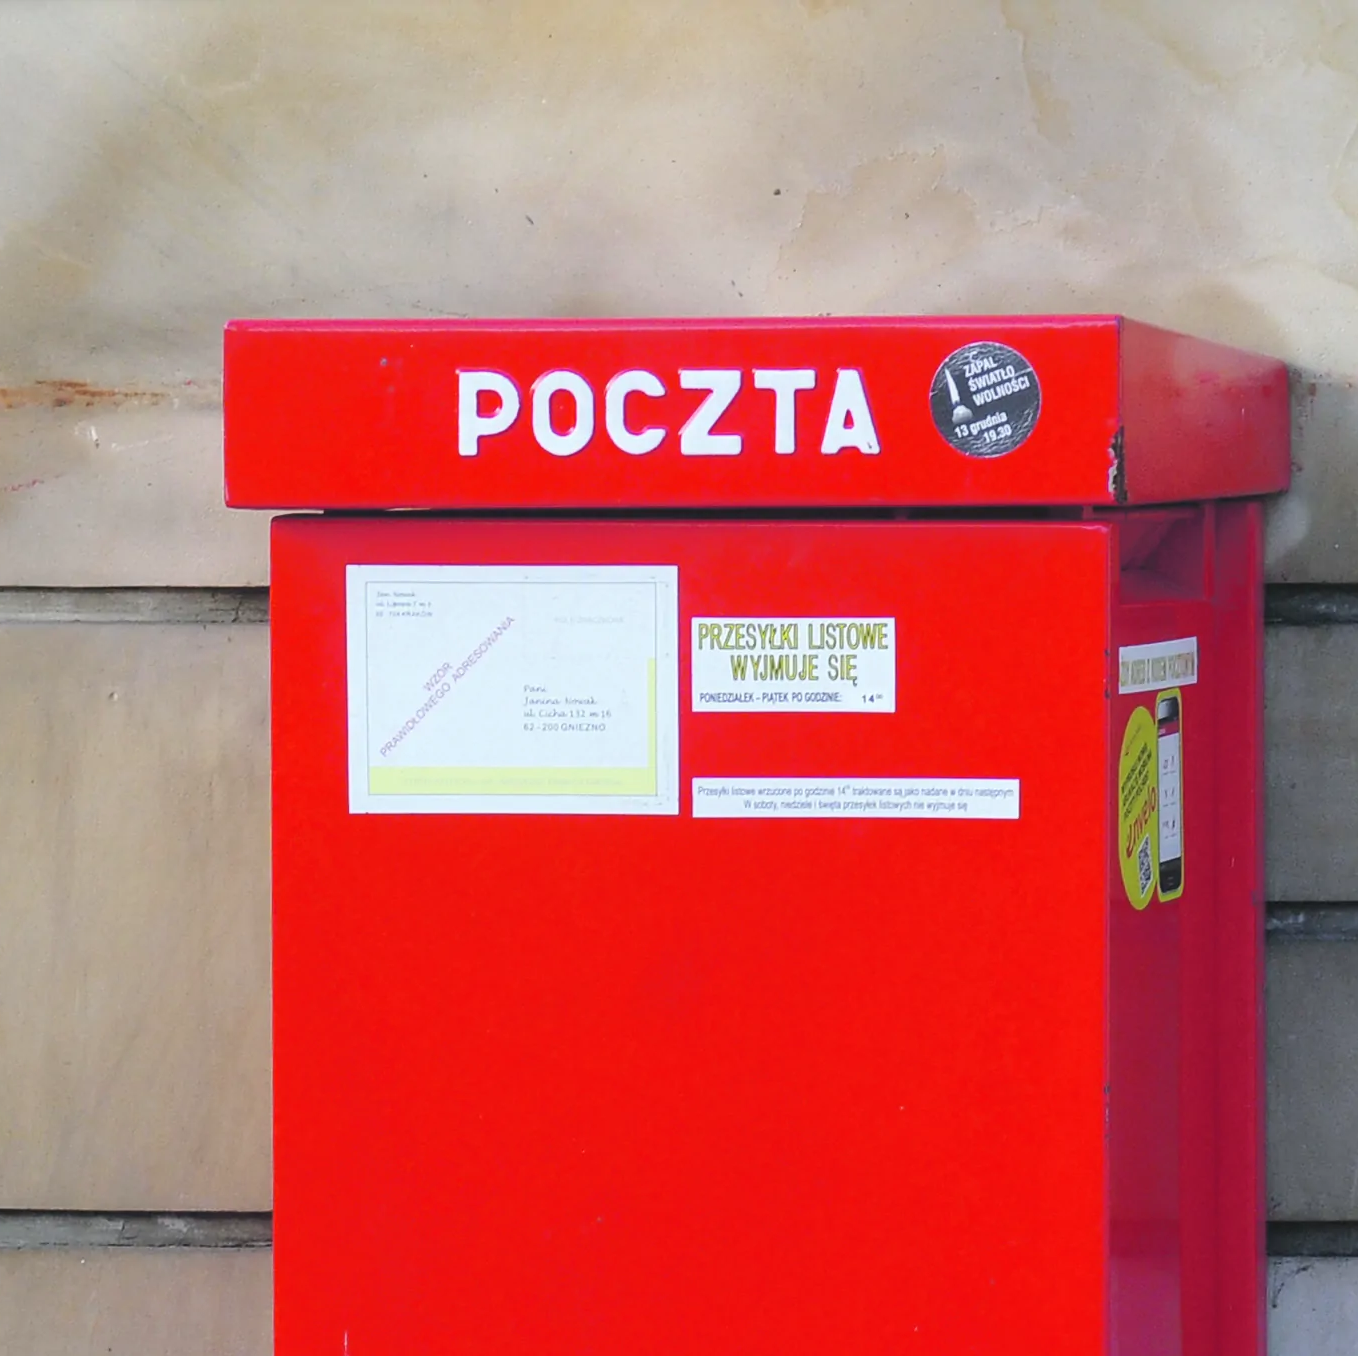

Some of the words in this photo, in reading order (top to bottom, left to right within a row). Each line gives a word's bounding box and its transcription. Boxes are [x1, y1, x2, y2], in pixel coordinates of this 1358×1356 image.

[968, 365, 1015, 391] ŚWIATŁO
[972, 376, 1030, 406] WOLNOŚCI
[458, 369, 880, 455] POCZTA
[954, 424, 969, 438] 13
[970, 412, 1008, 435] grudnia
[983, 424, 1012, 443] 19.30
[451, 616, 516, 683] ADRESOWANIA
[698, 623, 799, 650] PRZESYŁKI
[808, 623, 888, 650] LISTOWE
[730, 654, 819, 681] WYJMUJE
[828, 654, 858, 687] SIĘ
[792, 692, 802, 703] PO
